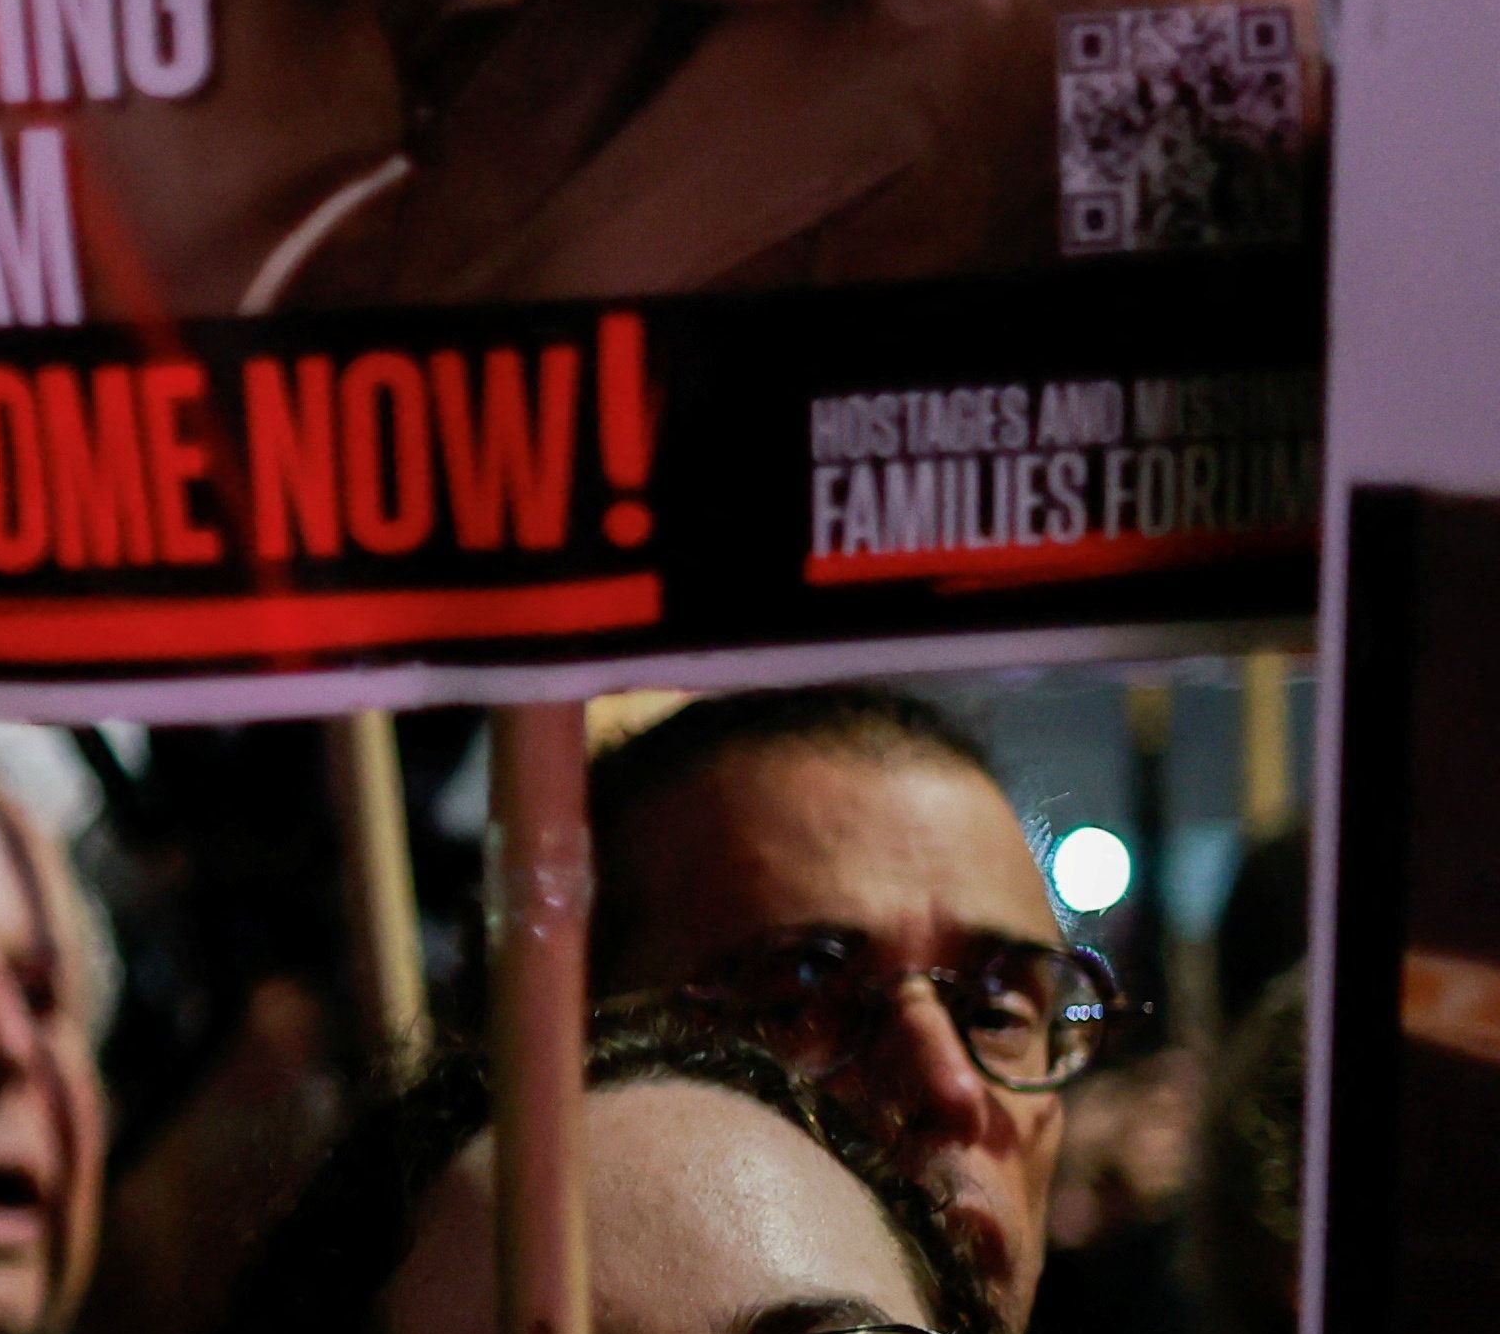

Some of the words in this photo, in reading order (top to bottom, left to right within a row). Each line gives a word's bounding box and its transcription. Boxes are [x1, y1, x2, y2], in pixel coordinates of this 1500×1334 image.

[241, 312, 660, 562] NOW!
[810, 381, 1030, 464] HOSTAGES
[1036, 379, 1124, 447] AND
[810, 450, 1089, 559] FAMILIES
